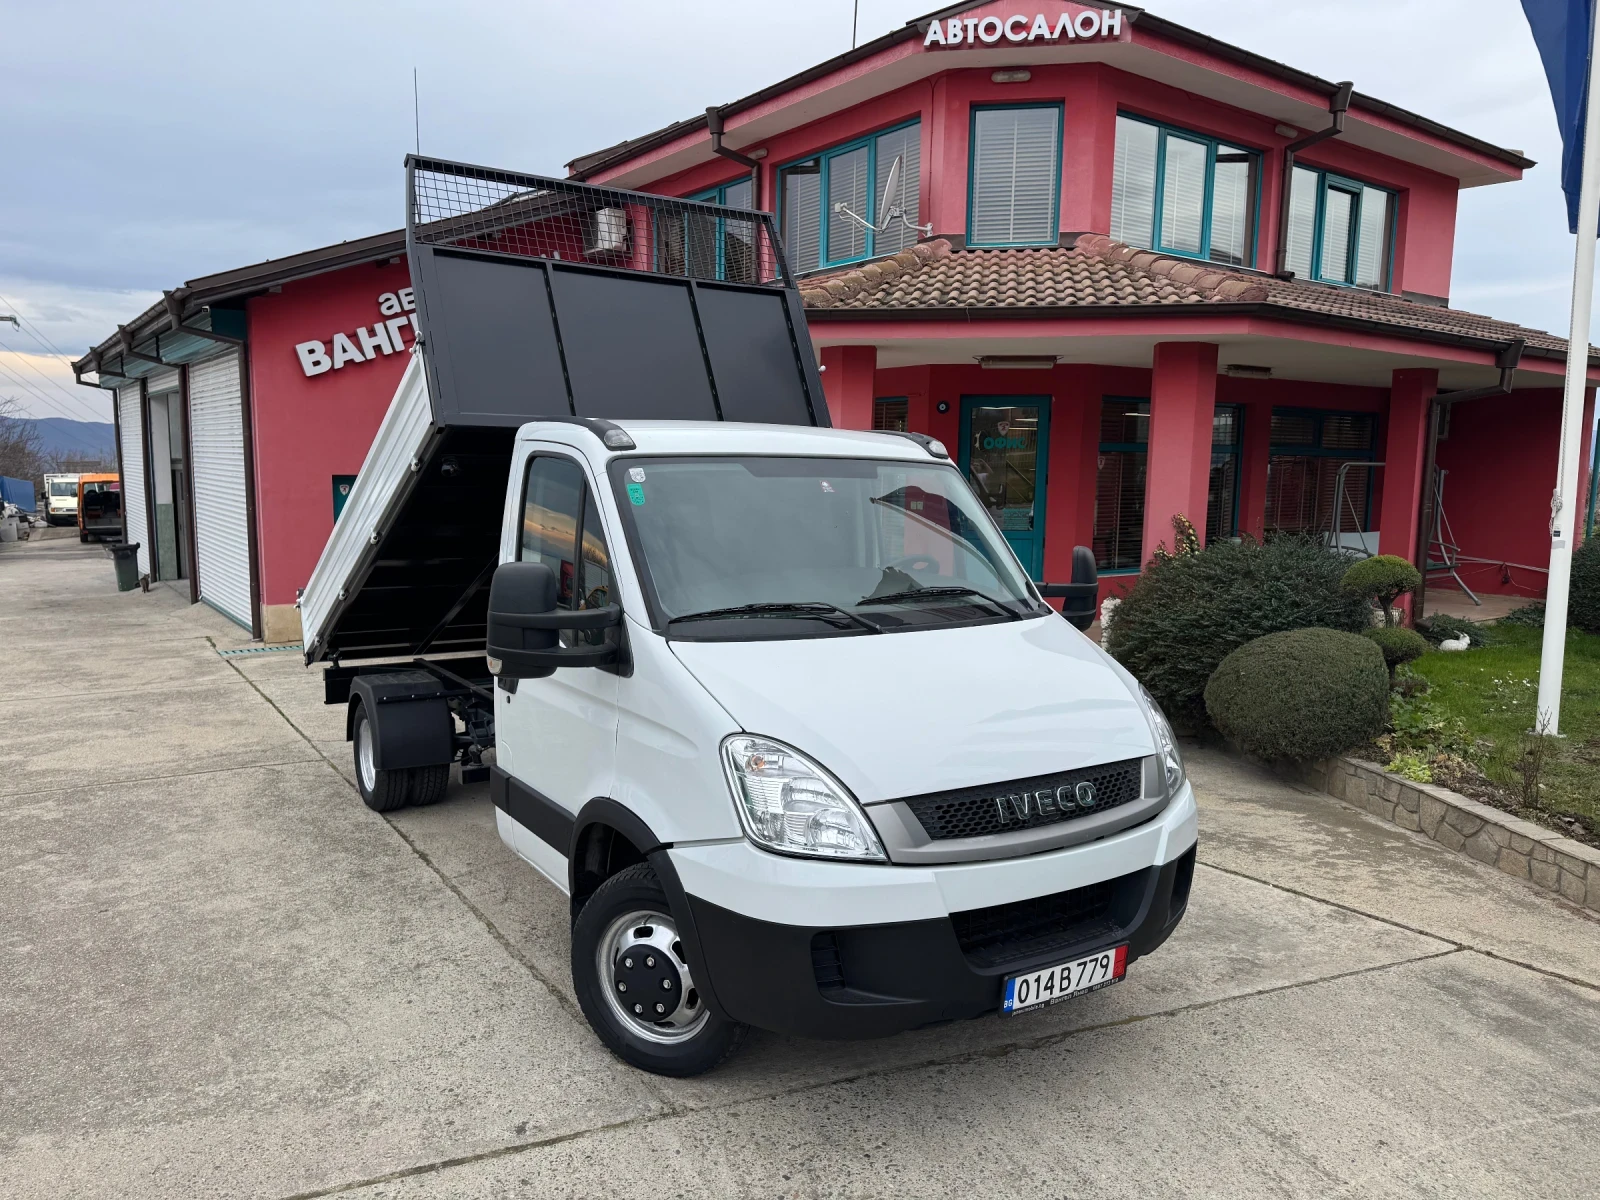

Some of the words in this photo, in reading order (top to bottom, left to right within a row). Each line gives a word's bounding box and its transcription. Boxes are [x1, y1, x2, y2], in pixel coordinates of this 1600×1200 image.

[923, 9, 1122, 47] АВТОСАЛОН
[983, 436, 1026, 450] ОФИС
[996, 781, 1097, 824] IVECO
[1017, 954, 1110, 1004] 014B779
